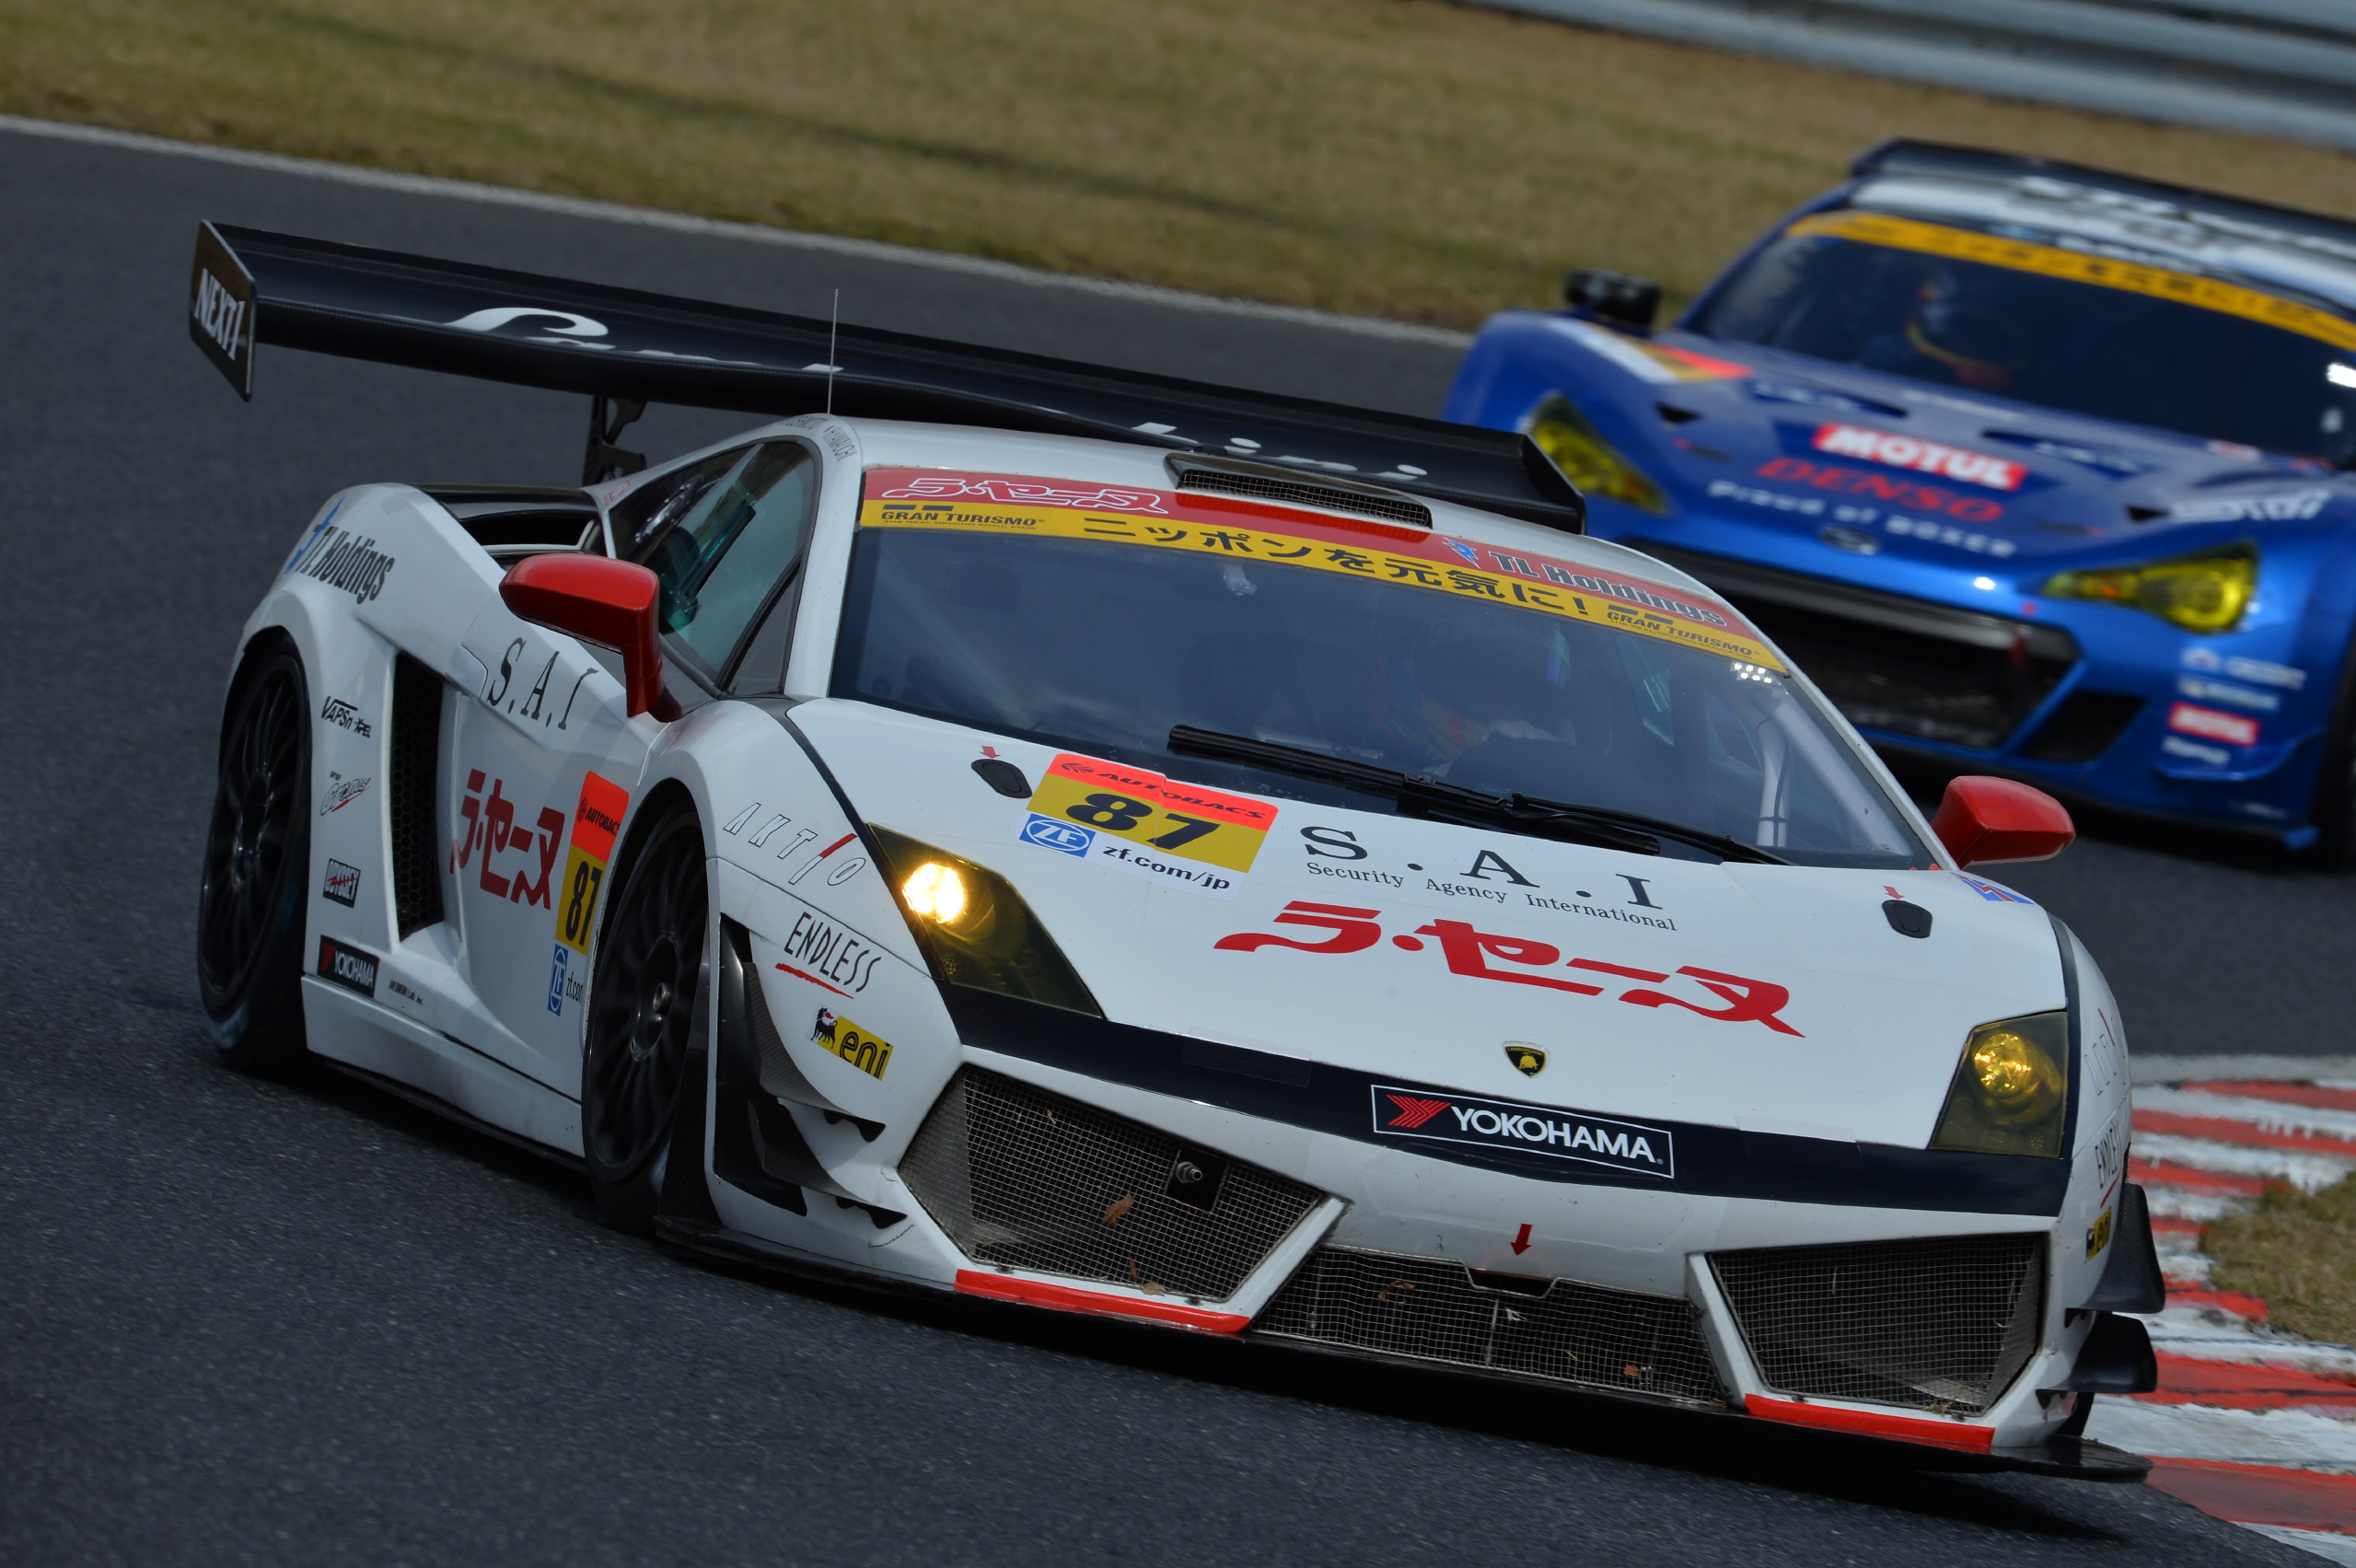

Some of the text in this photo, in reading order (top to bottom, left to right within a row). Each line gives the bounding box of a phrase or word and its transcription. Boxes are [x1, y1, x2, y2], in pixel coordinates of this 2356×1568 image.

[1817, 425, 2014, 491] MOTUL
[1757, 458, 2004, 522] DENSO
[881, 512, 1038, 527] GRAN TURISMO
[308, 530, 395, 605] Holdings
[1489, 552, 1727, 626] TL Holdings
[1607, 611, 1753, 656] GRAN TURISMO
[1065, 793, 1222, 851] 87
[1096, 772, 1266, 819] AUTOBACS
[1033, 822, 1079, 843] ZF
[1102, 845, 1231, 891] zf.com/jp
[565, 860, 603, 947] 87
[1306, 862, 1677, 932] Security Agency International
[334, 949, 374, 988] YOKOHAMA
[783, 912, 882, 993] ENDLESS
[840, 1030, 891, 1079] eni
[1450, 1106, 1657, 1163] YOKOHAMA
